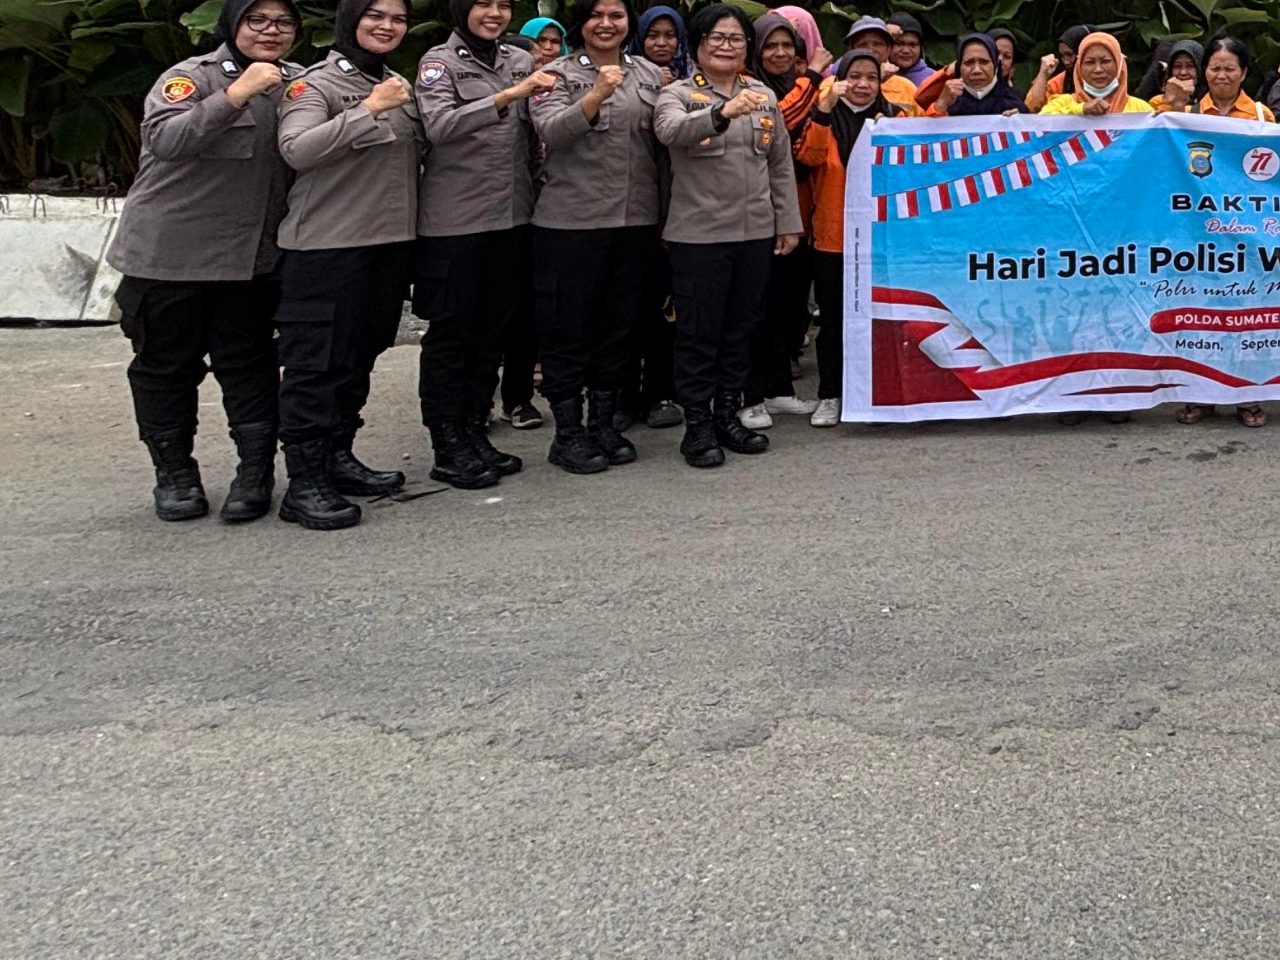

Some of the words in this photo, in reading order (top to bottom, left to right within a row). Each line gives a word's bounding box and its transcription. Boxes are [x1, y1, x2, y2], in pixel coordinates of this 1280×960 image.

[511, 71, 534, 79] POL
[1206, 218, 1256, 234] Dalam
[968, 247, 1046, 281] Hari
[1057, 243, 1137, 278] Jadi
[1150, 242, 1246, 274] Polisi
[1175, 313, 1222, 326] POLDA
[1175, 338, 1224, 352] Medan,
